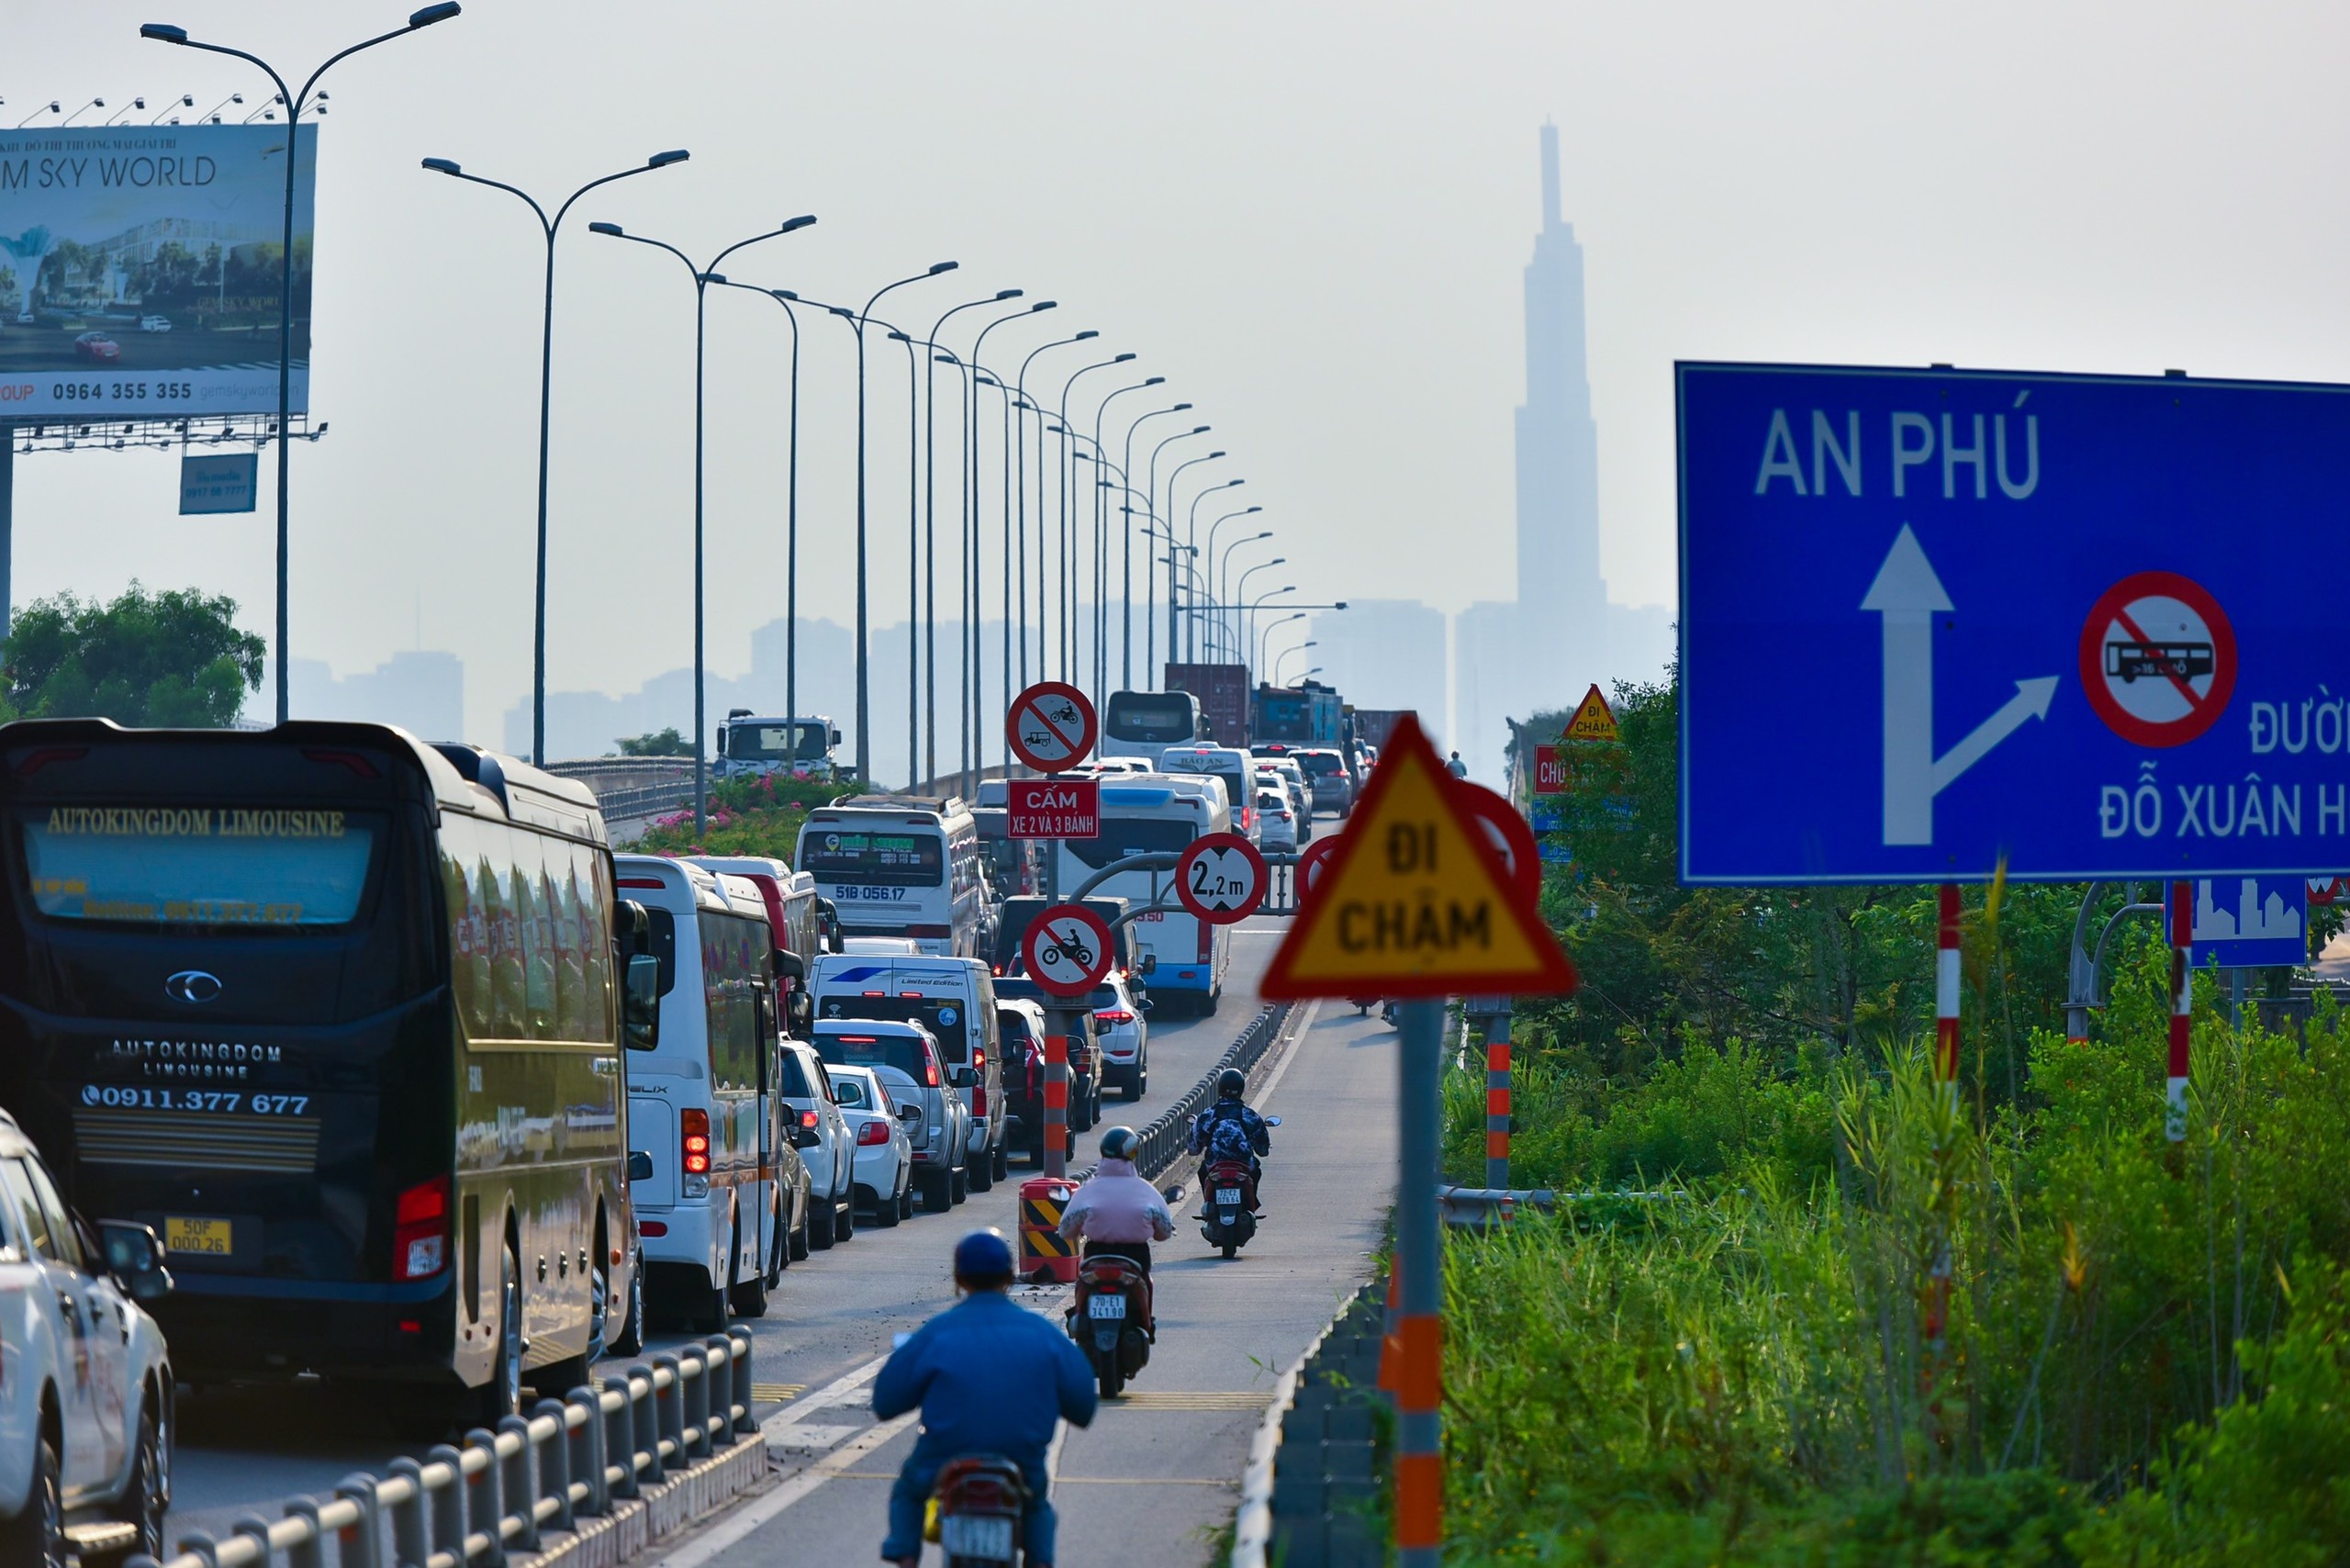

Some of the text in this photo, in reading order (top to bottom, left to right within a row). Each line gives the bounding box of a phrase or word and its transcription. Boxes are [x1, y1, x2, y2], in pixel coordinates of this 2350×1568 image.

[39, 157, 88, 188] SKY
[99, 156, 216, 187] WORLD
[0, 385, 35, 401] OUP
[53, 383, 102, 400] 0964
[112, 383, 147, 400] 355
[157, 382, 192, 399] 355
[1755, 390, 2040, 500] AN PHÚ
[1588, 706, 1600, 717] ĐI
[2248, 684, 2350, 754] ĐƯỜ
[1026, 784, 1078, 809] CẤM
[2099, 760, 2162, 838] ĐỖ
[2176, 772, 2300, 837] XUÂN
[48, 808, 345, 837] AUTOKINGDOM LIMOUSINE
[1013, 811, 1093, 833] XE 2 VÀ 3 BÁNH
[1386, 819, 1439, 875] ĐI
[1229, 879, 1244, 895] m
[112, 1039, 282, 1061] AUTOKINGDOM
[143, 1062, 249, 1079] LIMOUSINE
[102, 1088, 309, 1114] 0911.377 677
[184, 1219, 212, 1235] 50F
